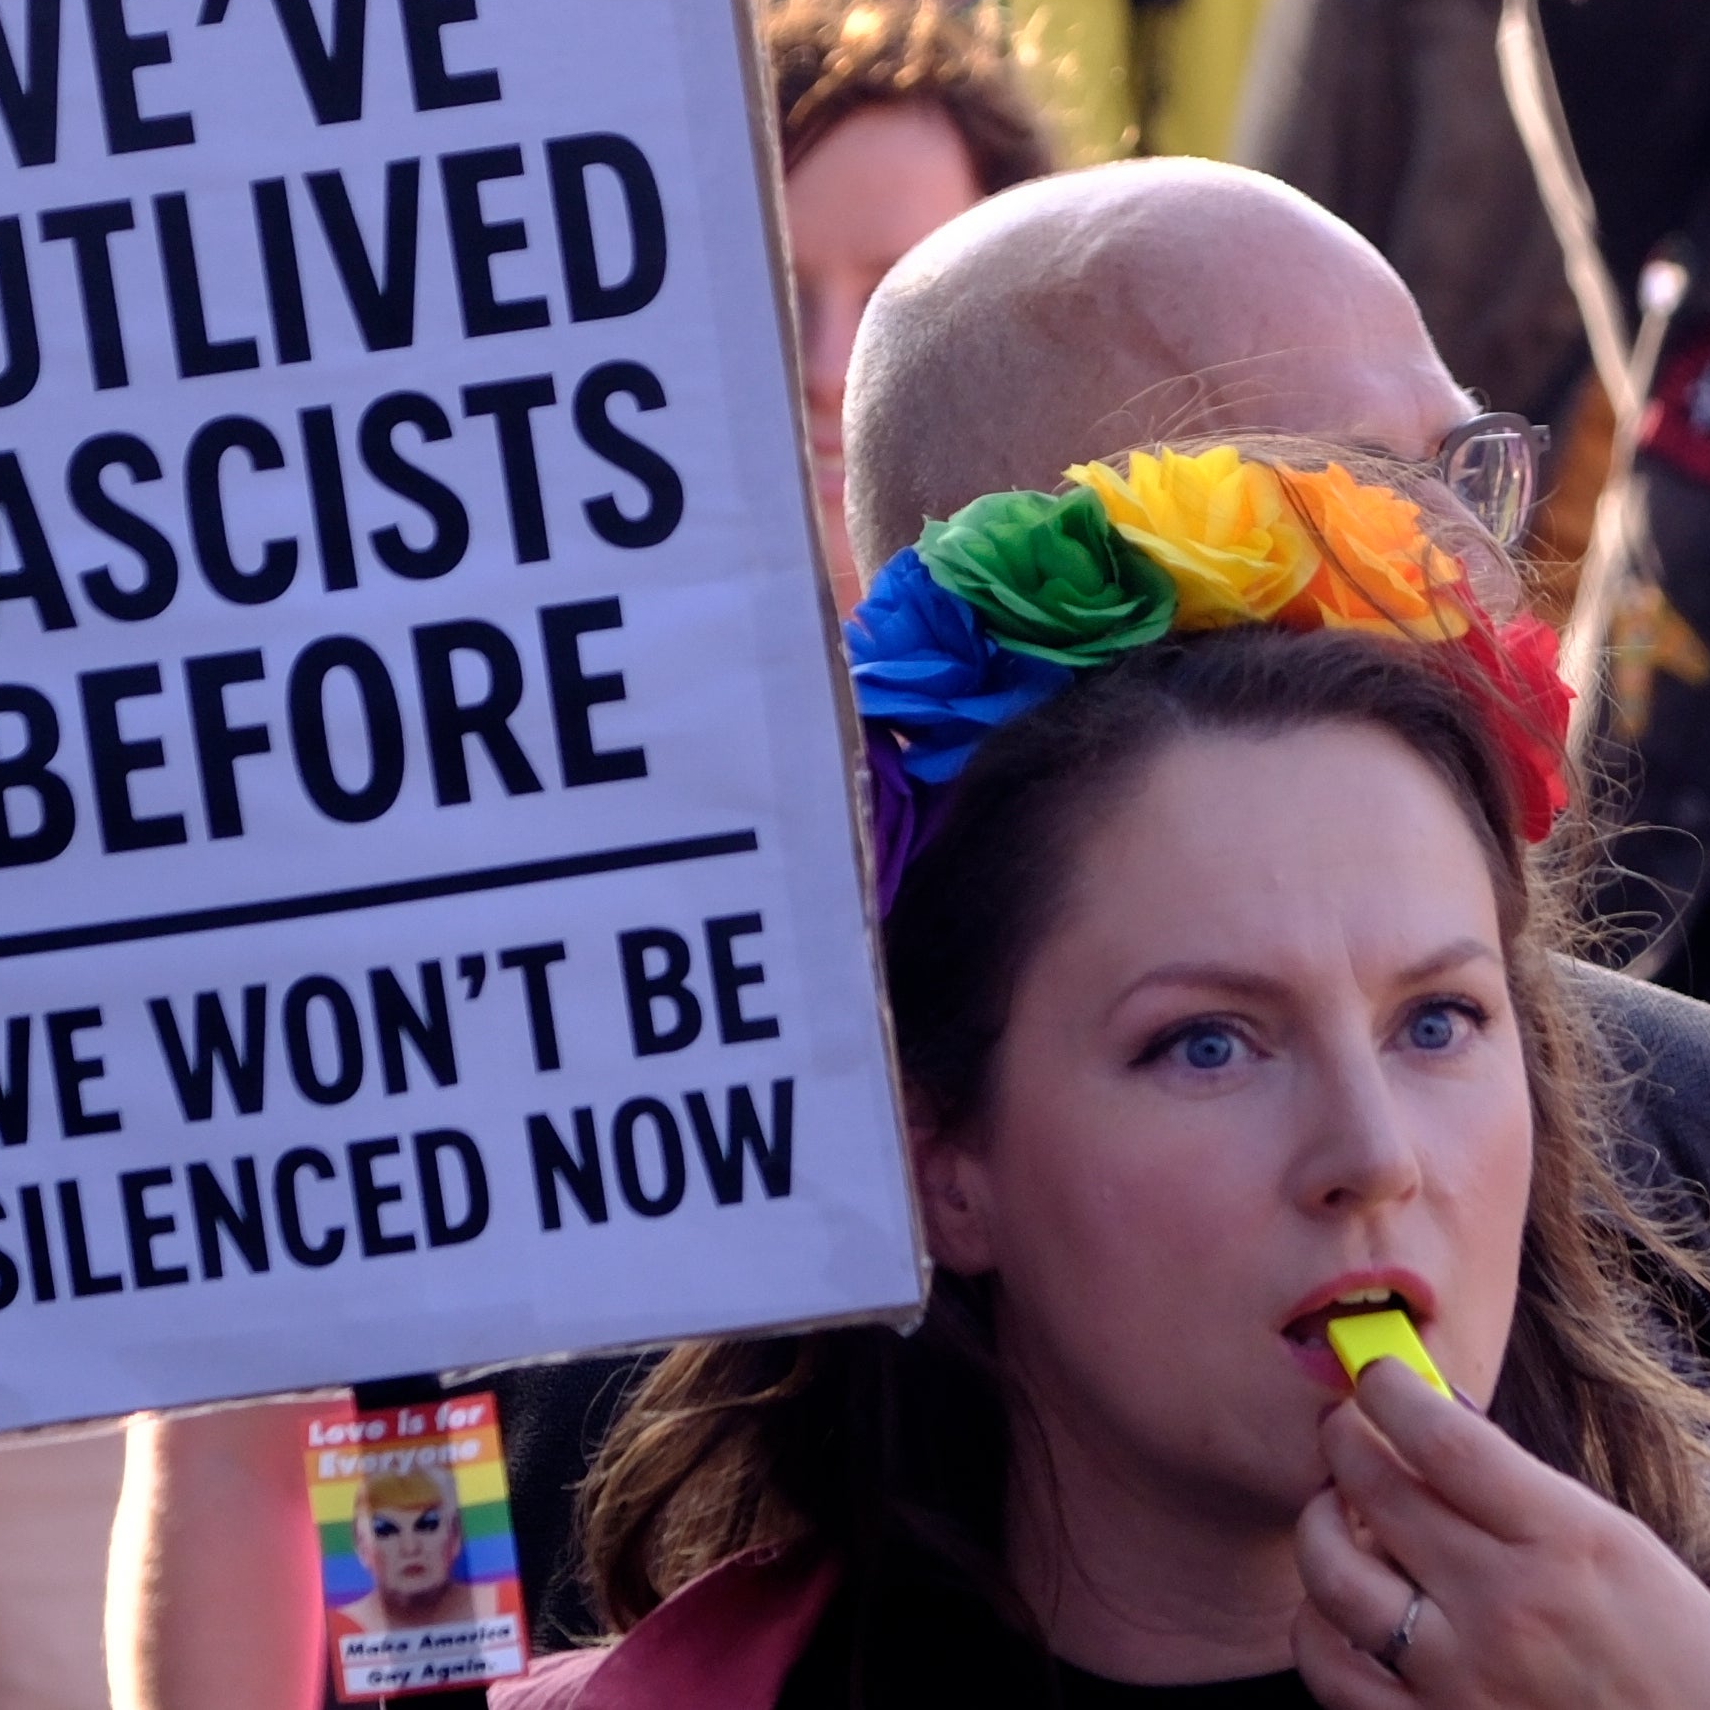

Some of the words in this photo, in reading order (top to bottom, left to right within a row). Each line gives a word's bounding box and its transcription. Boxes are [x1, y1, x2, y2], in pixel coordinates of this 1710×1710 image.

[146, 940, 568, 1122] WON'T
[617, 911, 779, 1057] BE
[530, 1076, 795, 1231] NOW
[308, 1419, 388, 1447] Love
[318, 1438, 482, 1479] Everyone
[419, 1624, 511, 1652] America
